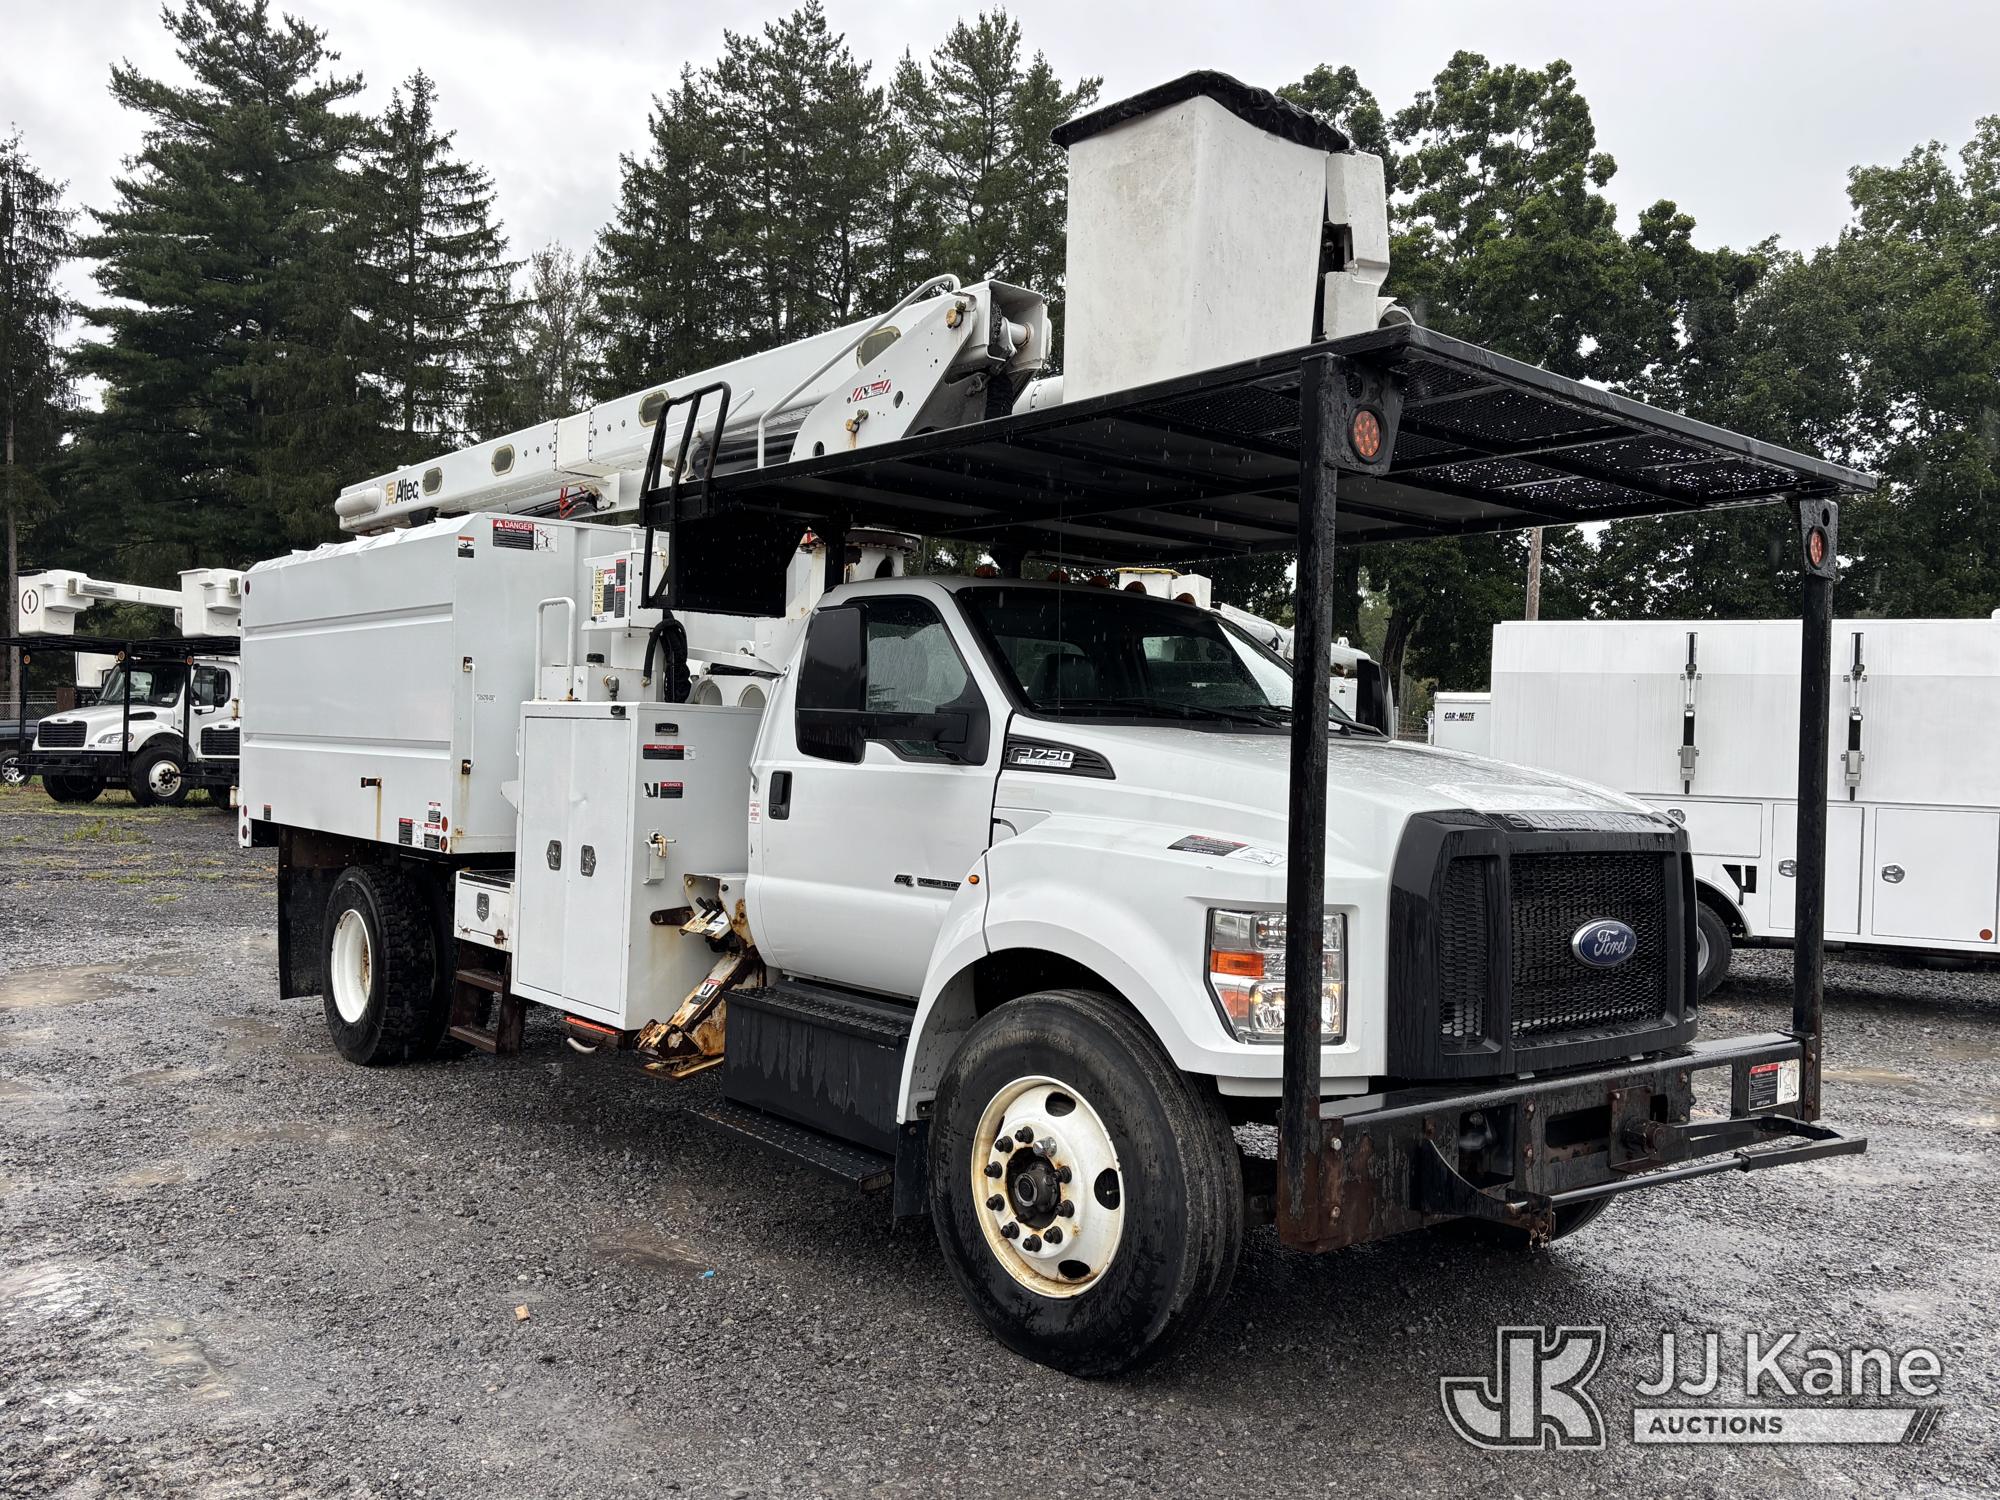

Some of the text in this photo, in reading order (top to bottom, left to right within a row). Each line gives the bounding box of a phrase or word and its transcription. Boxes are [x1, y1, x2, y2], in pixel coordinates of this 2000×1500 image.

[396, 478, 419, 504] Altec
[504, 520, 533, 531] DANGER
[1594, 929, 1628, 957] Ford
